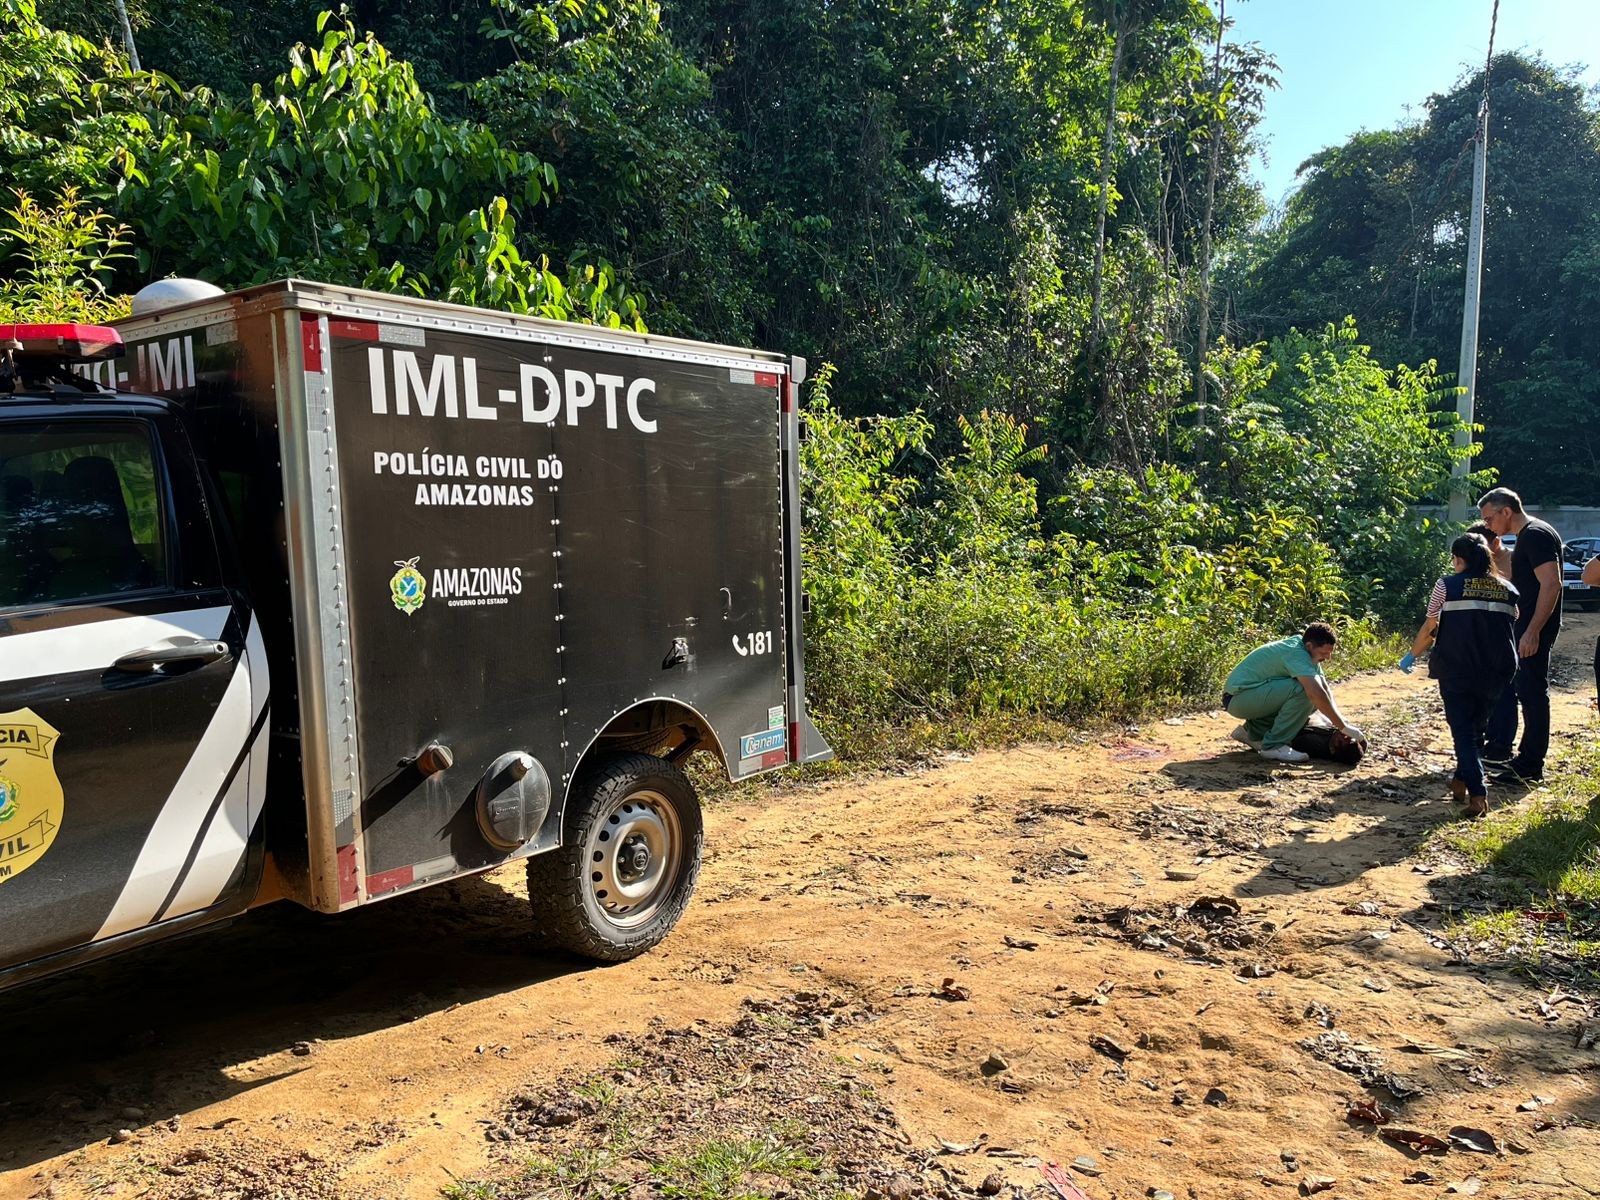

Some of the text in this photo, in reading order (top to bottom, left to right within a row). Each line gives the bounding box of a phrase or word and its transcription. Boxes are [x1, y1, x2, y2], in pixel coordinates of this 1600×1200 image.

[368, 347, 658, 433] IML-DPTC
[373, 447, 563, 480] POLÍCIA CIVIL DO
[414, 483, 534, 506] AMAZONAS
[431, 566, 522, 598] AMAZONAS
[447, 599, 476, 607] GOVERNO
[486, 597, 508, 605] ESTADO
[1462, 591, 1509, 600] AMAZONAS
[747, 630, 772, 656] 181
